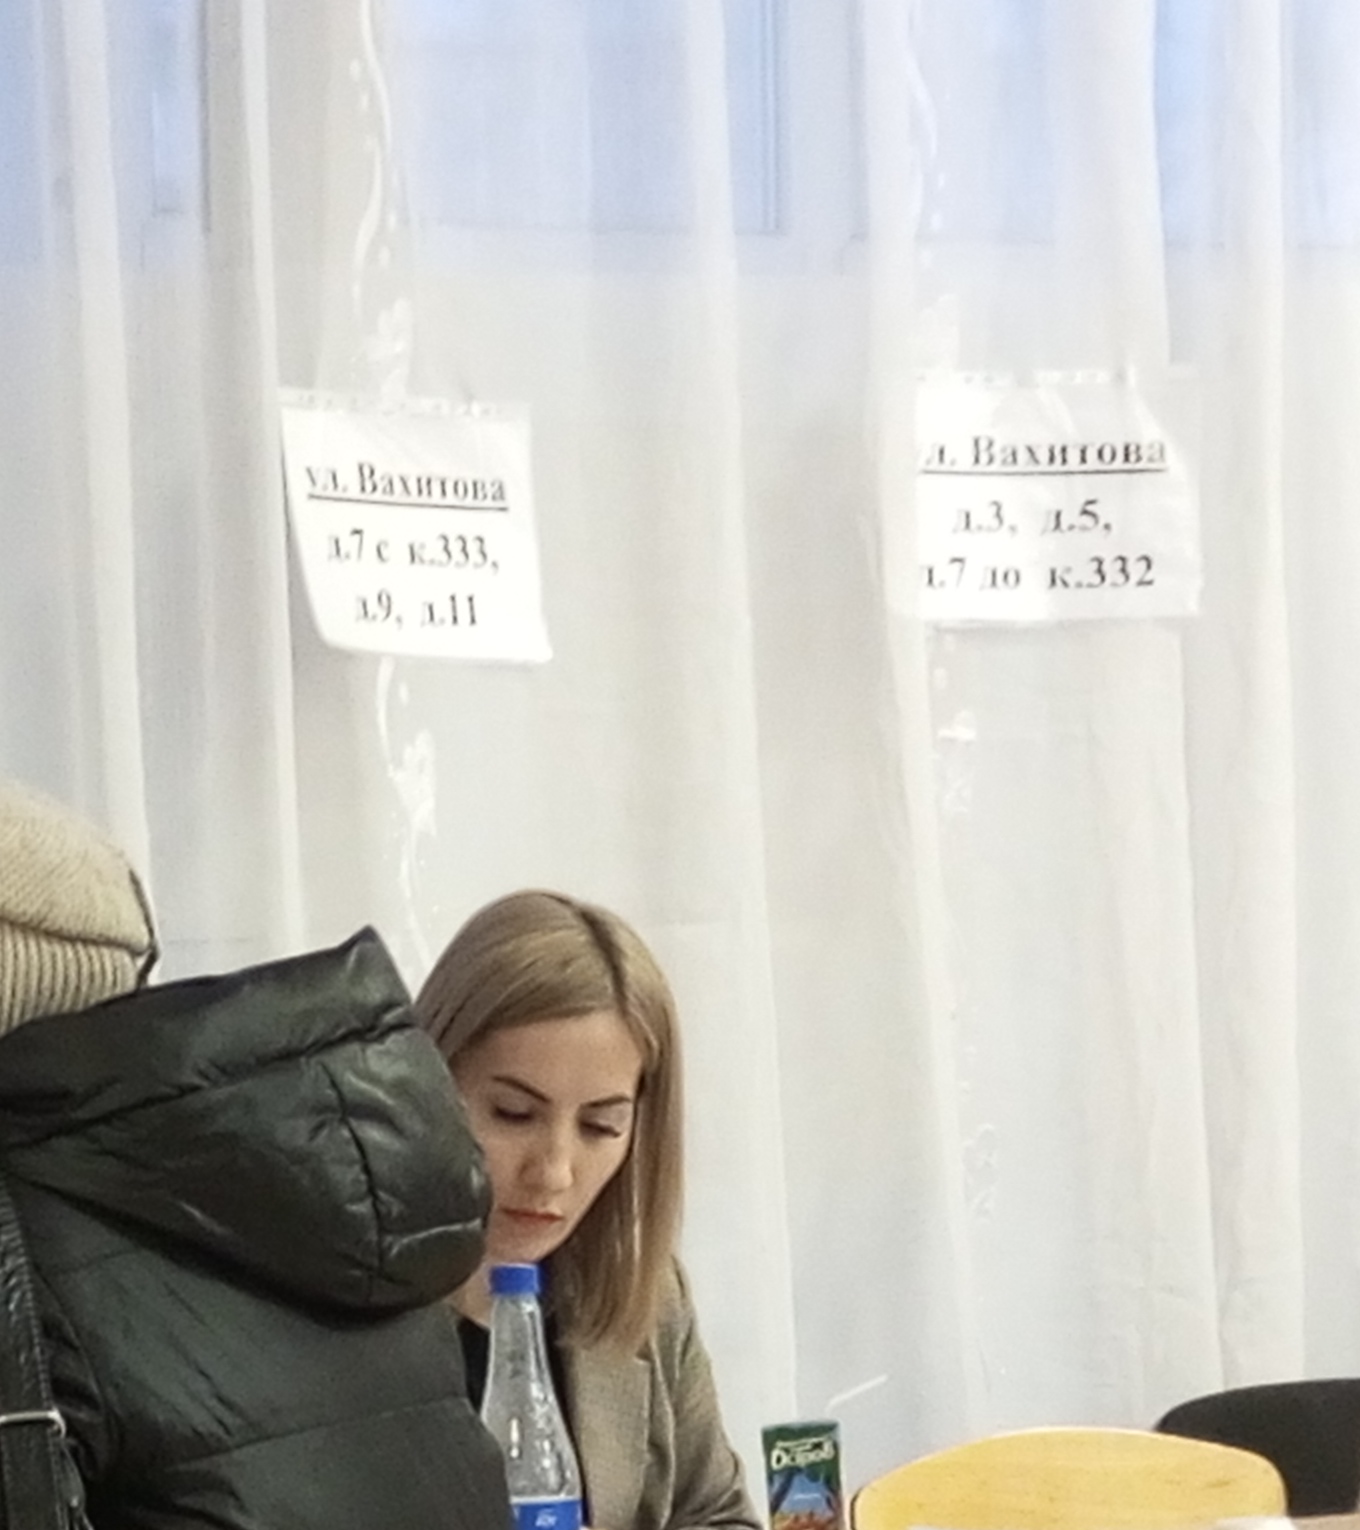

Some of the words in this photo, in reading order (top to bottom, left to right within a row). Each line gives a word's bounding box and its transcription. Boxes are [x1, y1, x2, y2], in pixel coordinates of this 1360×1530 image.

[924, 442, 957, 467] л.
[971, 435, 1167, 467] Вахитова
[306, 466, 348, 493] ул.
[357, 461, 508, 502] Вахитова
[952, 500, 1019, 537] д.3,
[1040, 498, 1113, 537] д.5,
[328, 528, 365, 563] д.7
[376, 540, 391, 563] с
[408, 533, 500, 575] к.333,
[979, 565, 1022, 591] до
[1048, 553, 1156, 590] к.332
[355, 588, 403, 630] д.9,
[420, 593, 478, 627] д.11
